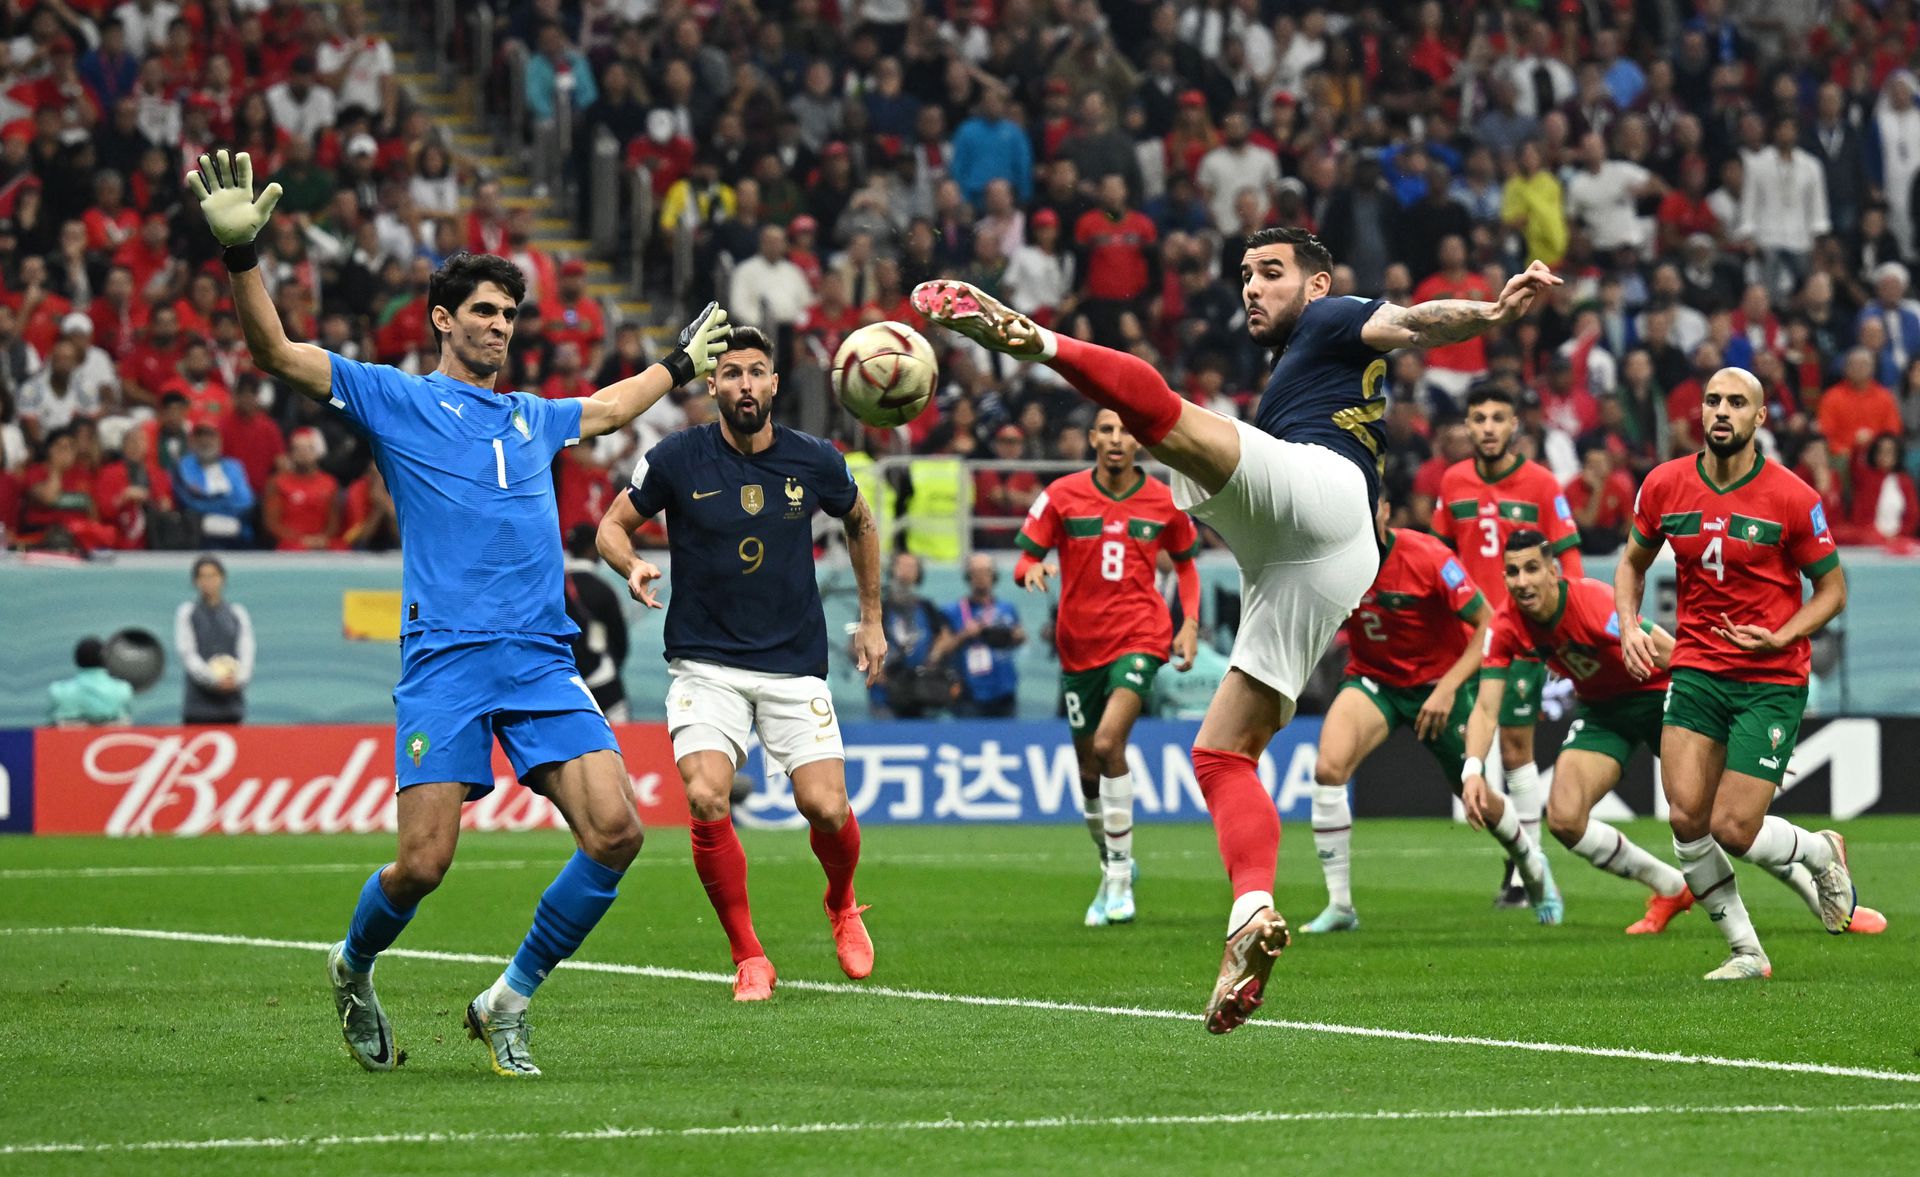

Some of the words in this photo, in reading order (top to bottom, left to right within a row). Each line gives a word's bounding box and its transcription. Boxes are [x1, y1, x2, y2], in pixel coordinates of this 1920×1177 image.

[492, 438, 508, 489] 1
[738, 536, 764, 575] 9
[1479, 518, 1499, 558] 3
[1102, 541, 1125, 581] 8
[1701, 536, 1724, 582] 4
[1360, 611, 1387, 640] 2
[810, 697, 832, 728] 9
[1064, 692, 1085, 728] 8
[843, 740, 1022, 819] 万达
